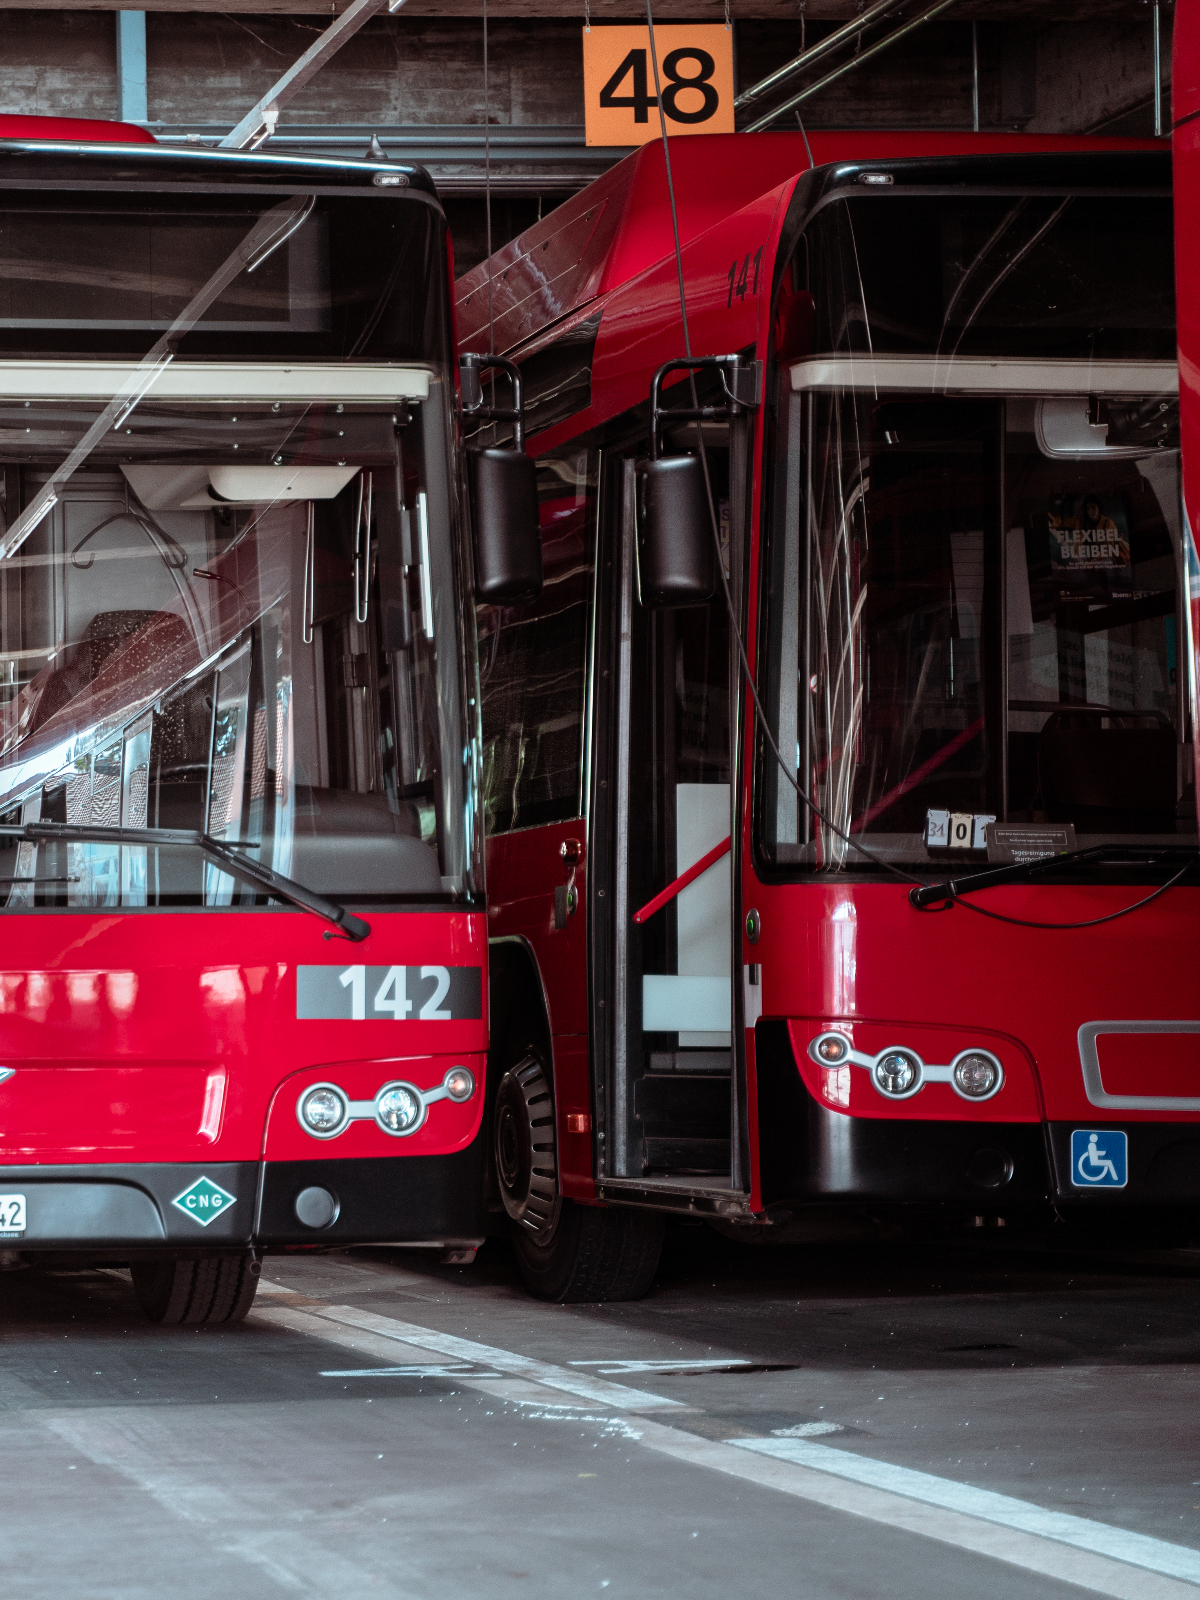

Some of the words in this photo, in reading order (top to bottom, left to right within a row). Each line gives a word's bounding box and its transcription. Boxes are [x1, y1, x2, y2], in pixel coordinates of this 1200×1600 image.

[600, 47, 719, 124] 48
[727, 246, 763, 309] 141
[1057, 528, 1122, 543] FLEXIBEL
[1061, 544, 1120, 559] BLEIBEN
[339, 965, 451, 1020] 142
[186, 1194, 222, 1208] CNG
